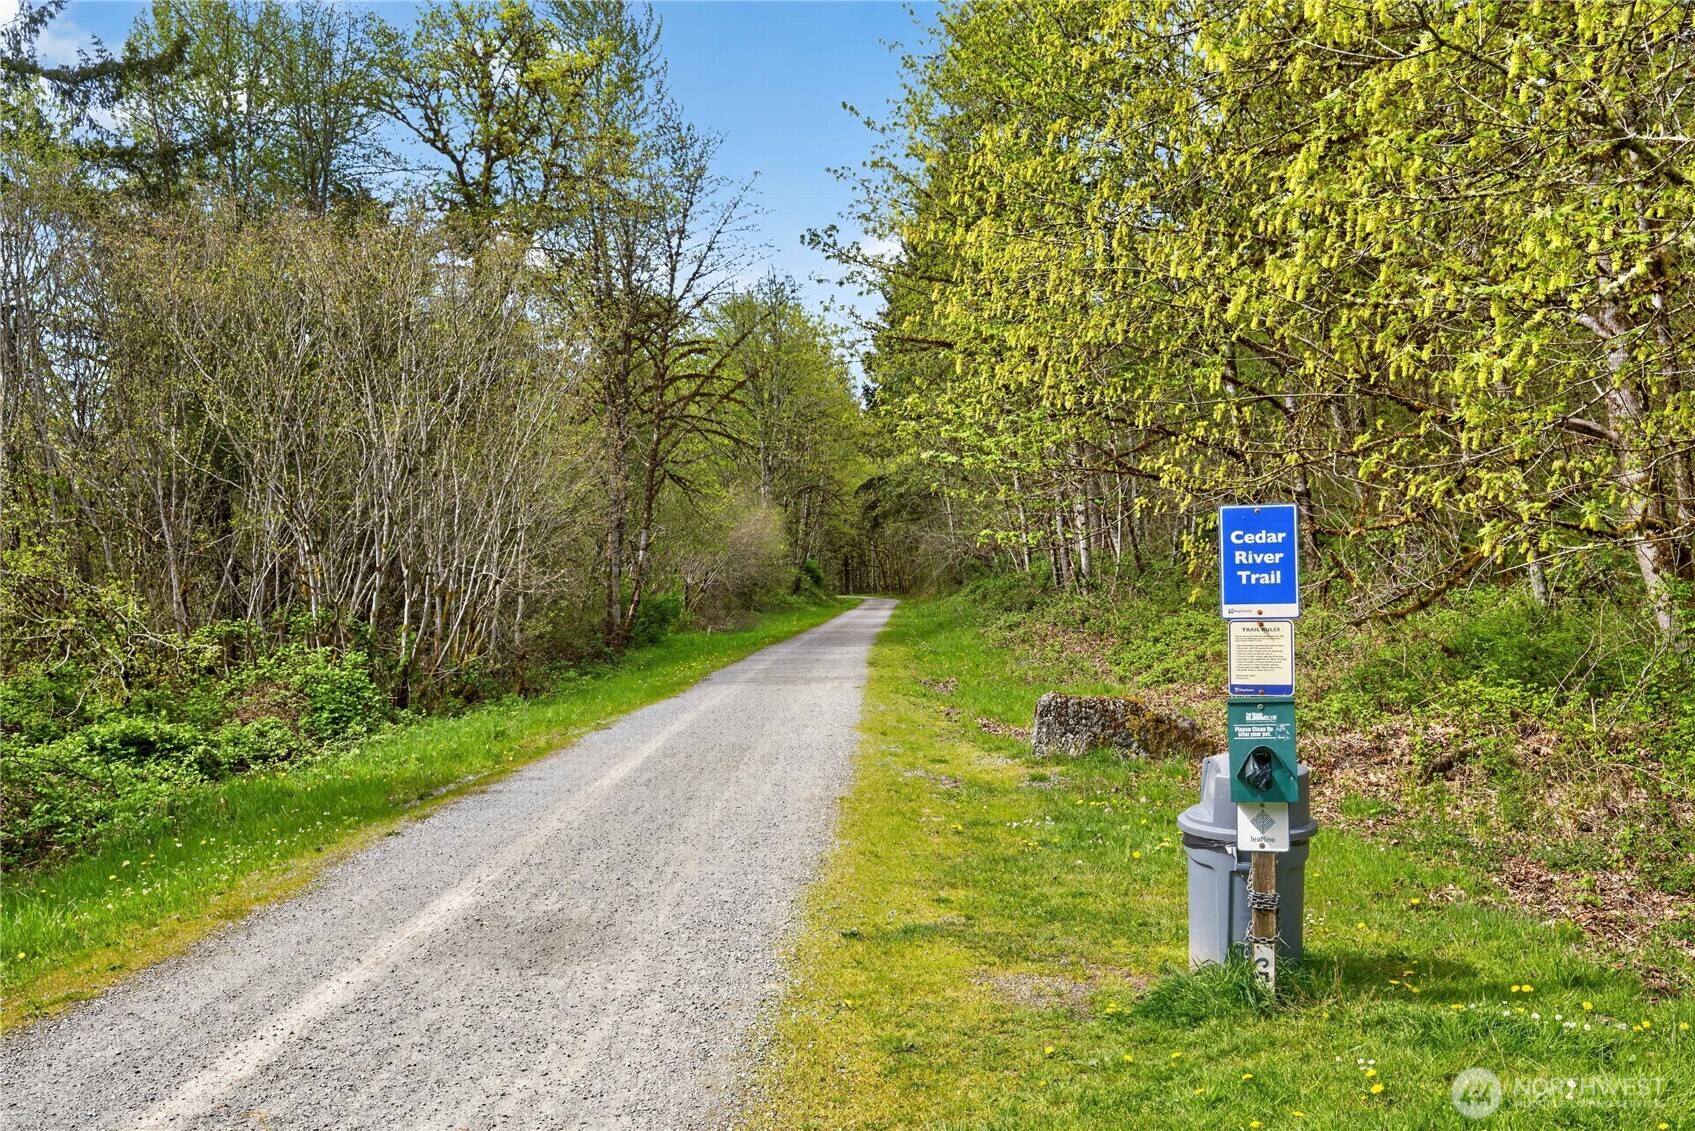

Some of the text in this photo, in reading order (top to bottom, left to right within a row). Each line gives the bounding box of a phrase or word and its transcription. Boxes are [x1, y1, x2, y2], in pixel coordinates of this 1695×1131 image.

[1230, 530, 1287, 544] Cedar
[1234, 550, 1284, 564] River
[1236, 570, 1281, 585] Trail
